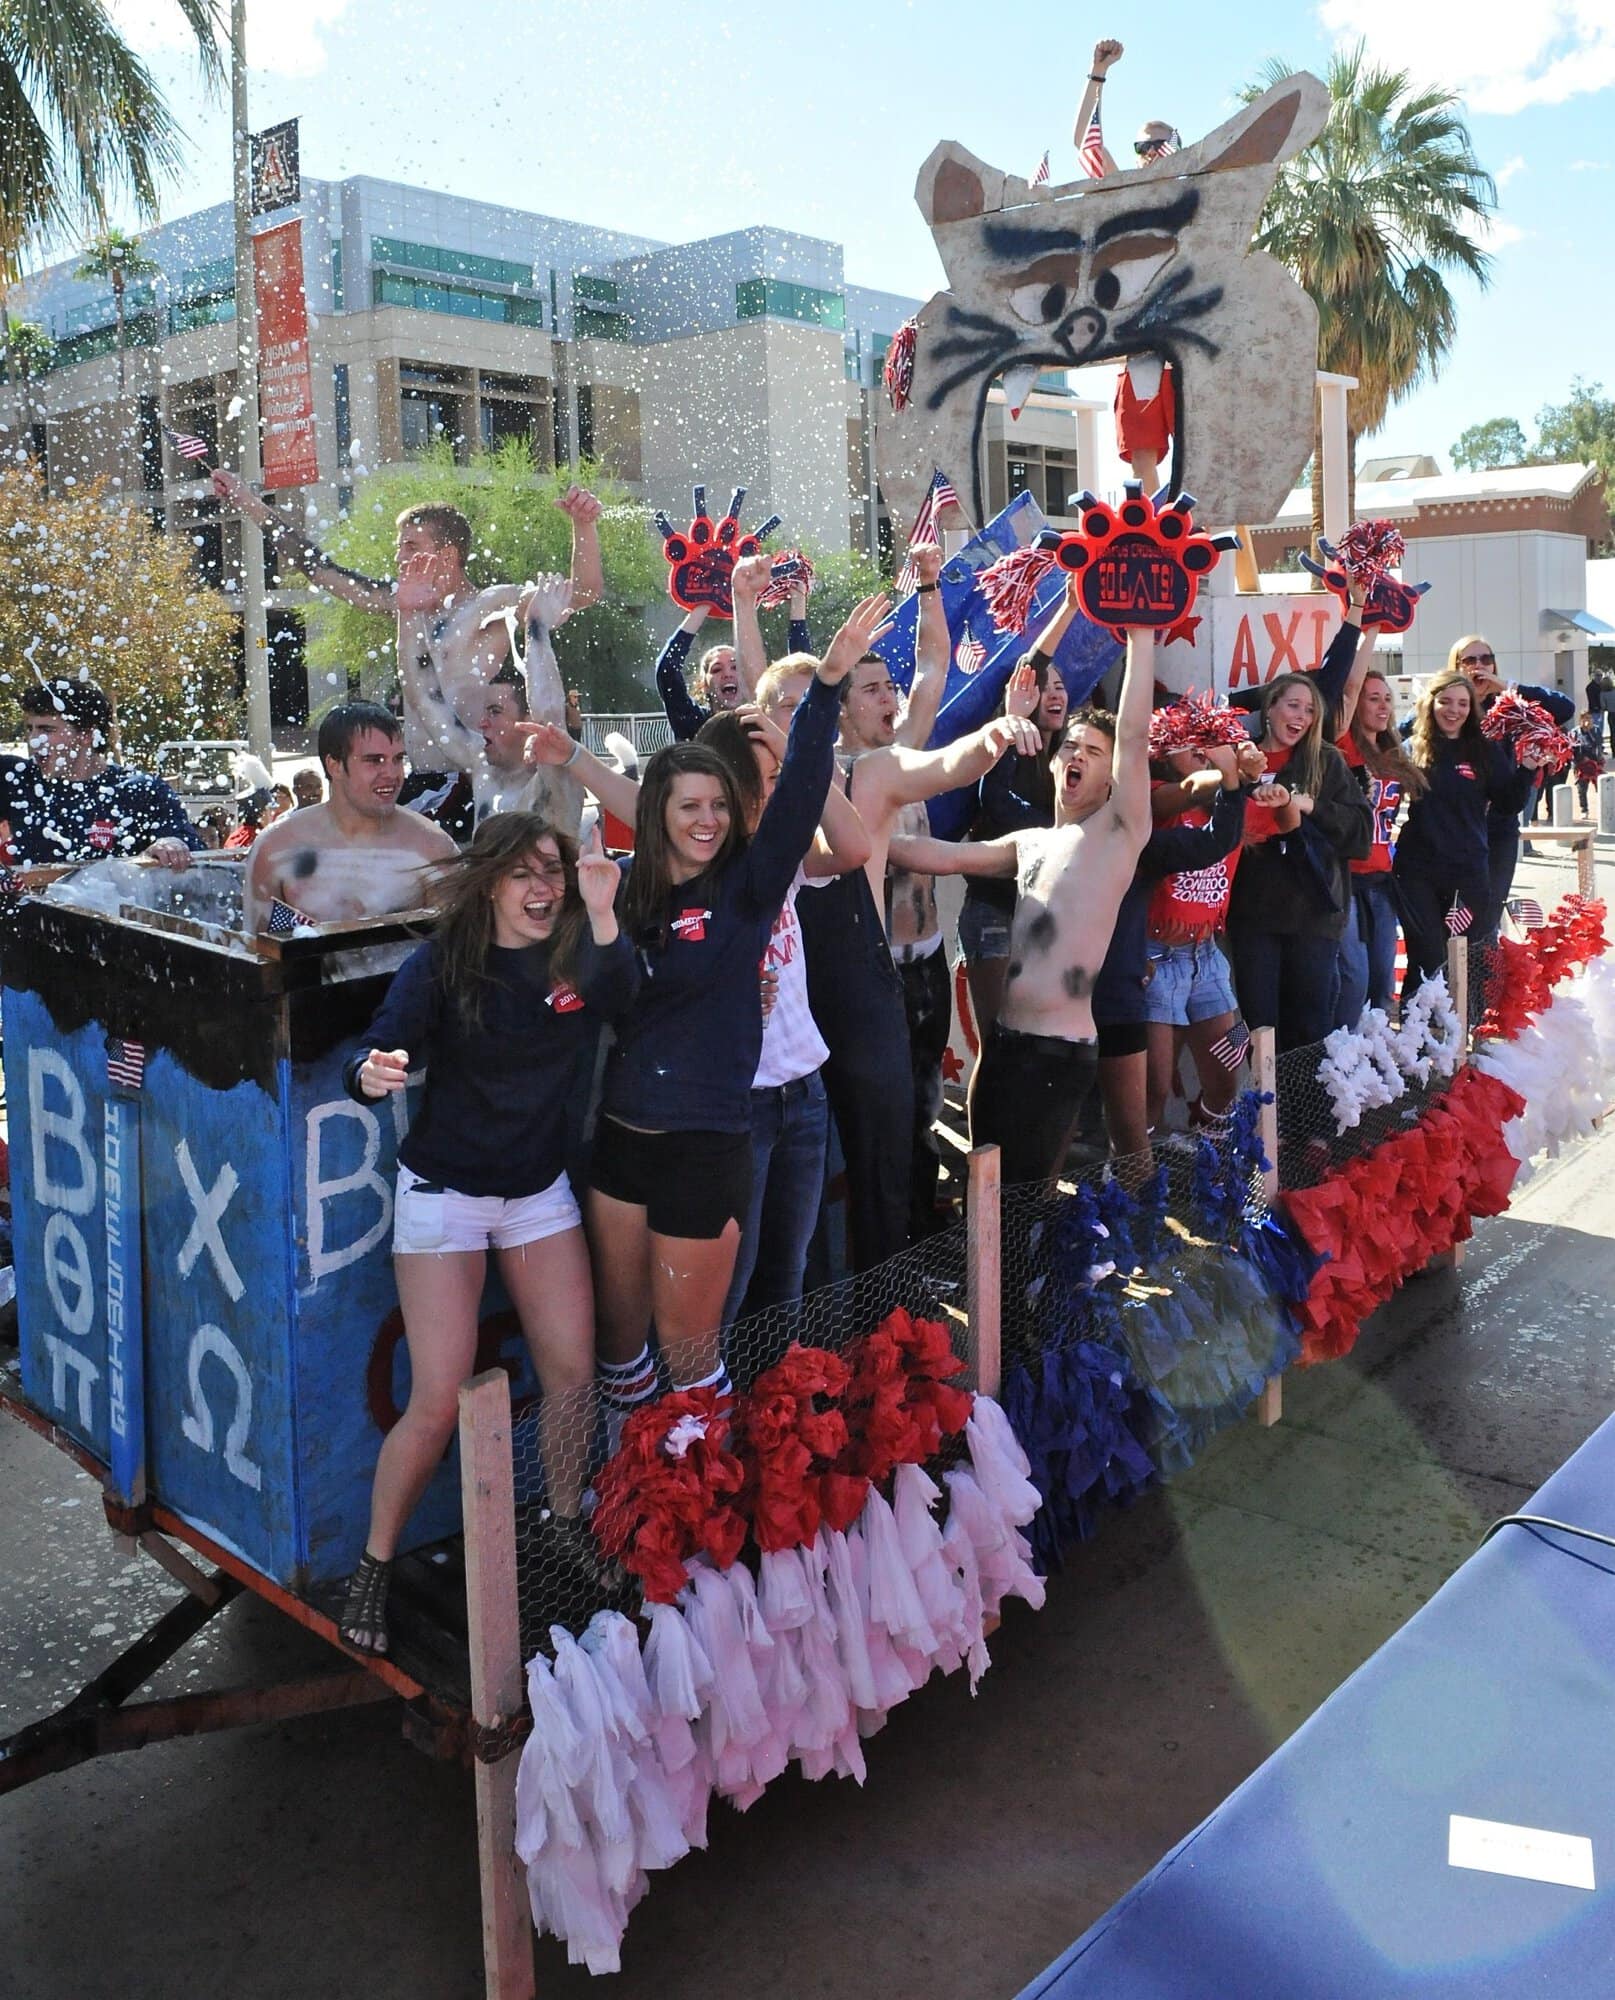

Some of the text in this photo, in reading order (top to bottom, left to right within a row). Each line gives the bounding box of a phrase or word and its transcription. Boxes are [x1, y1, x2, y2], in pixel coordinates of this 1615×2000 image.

[260, 361, 308, 381] hampions
[264, 417, 311, 437] Smming
[559, 992, 577, 1006] 2011
